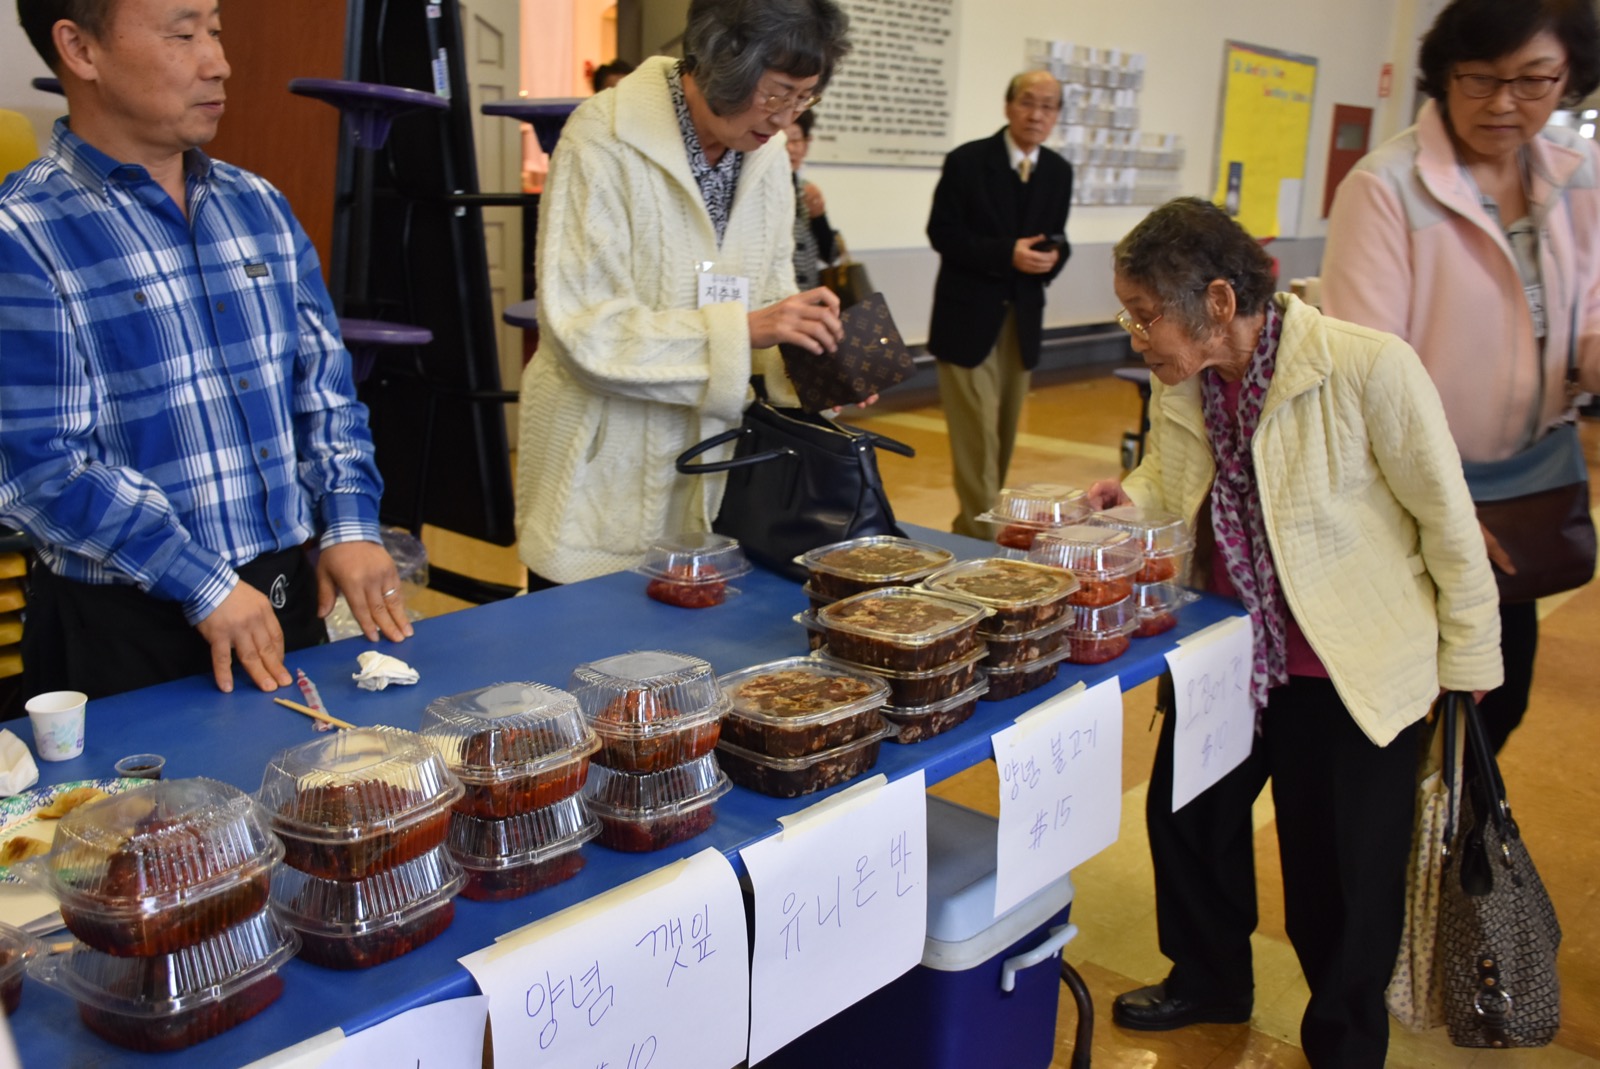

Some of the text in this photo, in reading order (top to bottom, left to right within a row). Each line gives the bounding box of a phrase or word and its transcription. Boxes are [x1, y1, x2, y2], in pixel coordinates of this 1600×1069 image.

[1004, 719, 1098, 800] 양념 불고기
[1028, 795, 1073, 850] $15
[526, 961, 613, 1049] 양념
